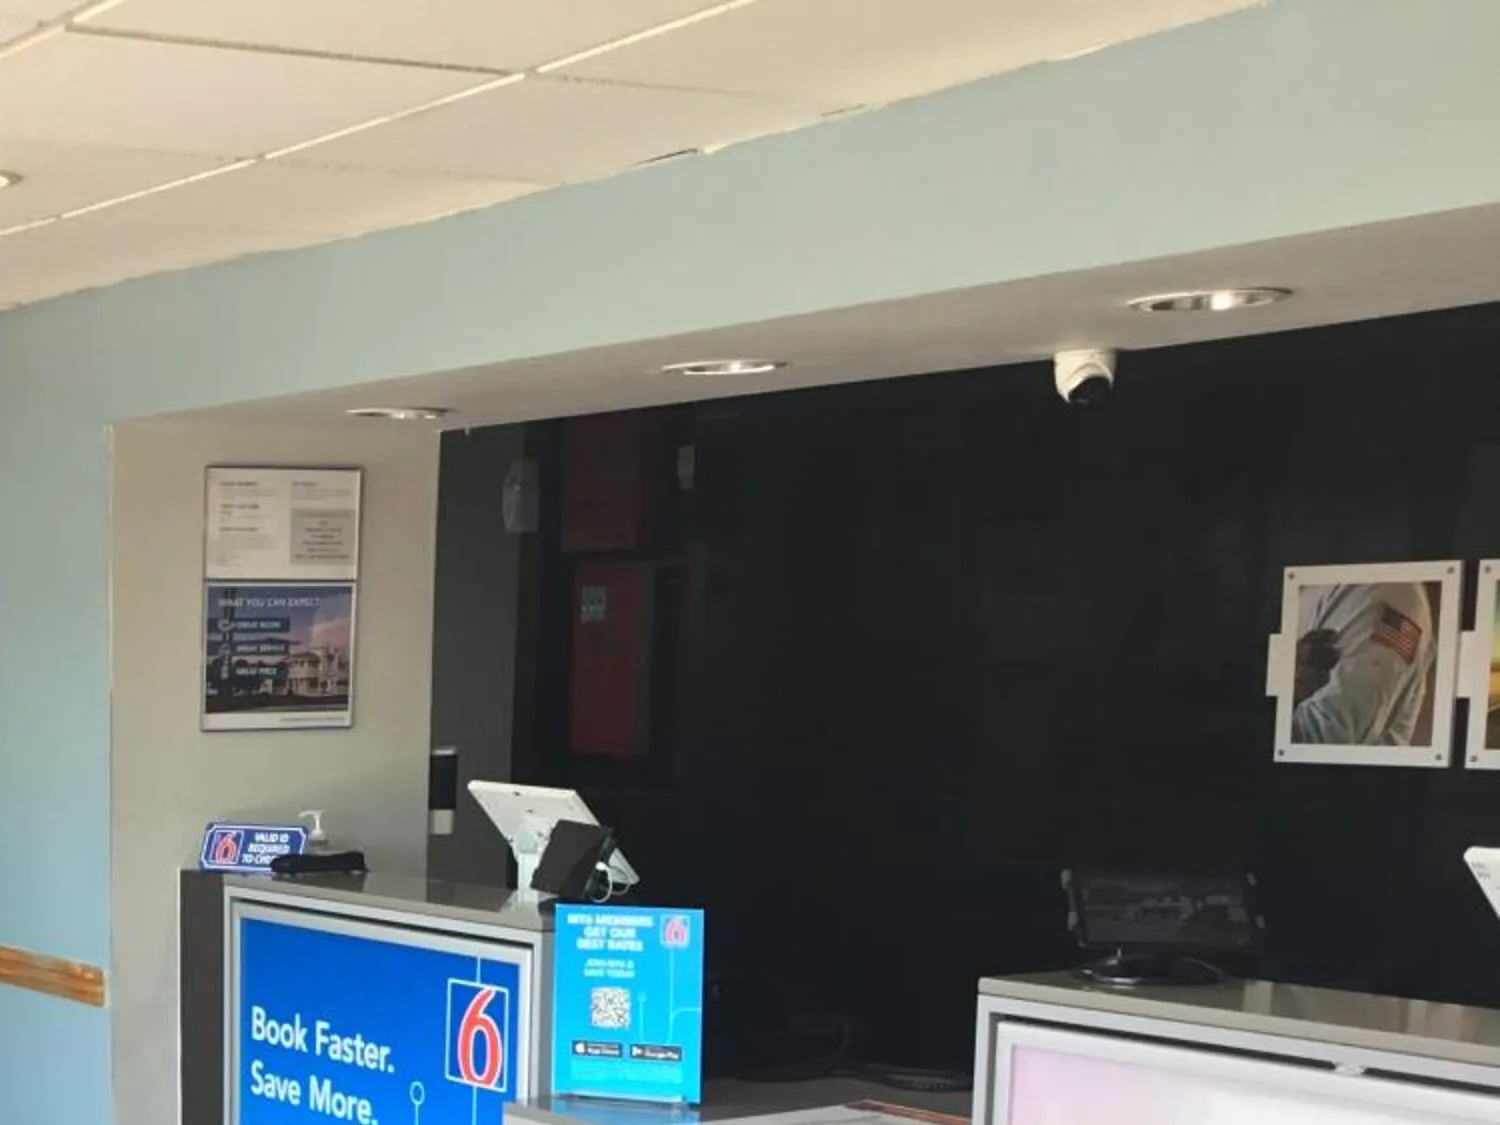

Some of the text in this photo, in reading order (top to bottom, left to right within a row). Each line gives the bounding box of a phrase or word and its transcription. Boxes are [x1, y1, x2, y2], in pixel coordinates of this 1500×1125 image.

[246, 598, 265, 608] YOU
[267, 598, 286, 608] CAN
[255, 832, 289, 843] VALID ID
[247, 843, 290, 855] REQUIRED
[242, 853, 254, 864] TO
[595, 914, 654, 928] MEMBERS
[583, 926, 636, 938] GET OUR
[576, 937, 644, 952] BEST RATES
[251, 1005, 395, 1073] Book Faster.
[457, 987, 503, 1088] 6
[250, 1059, 302, 1106] Save
